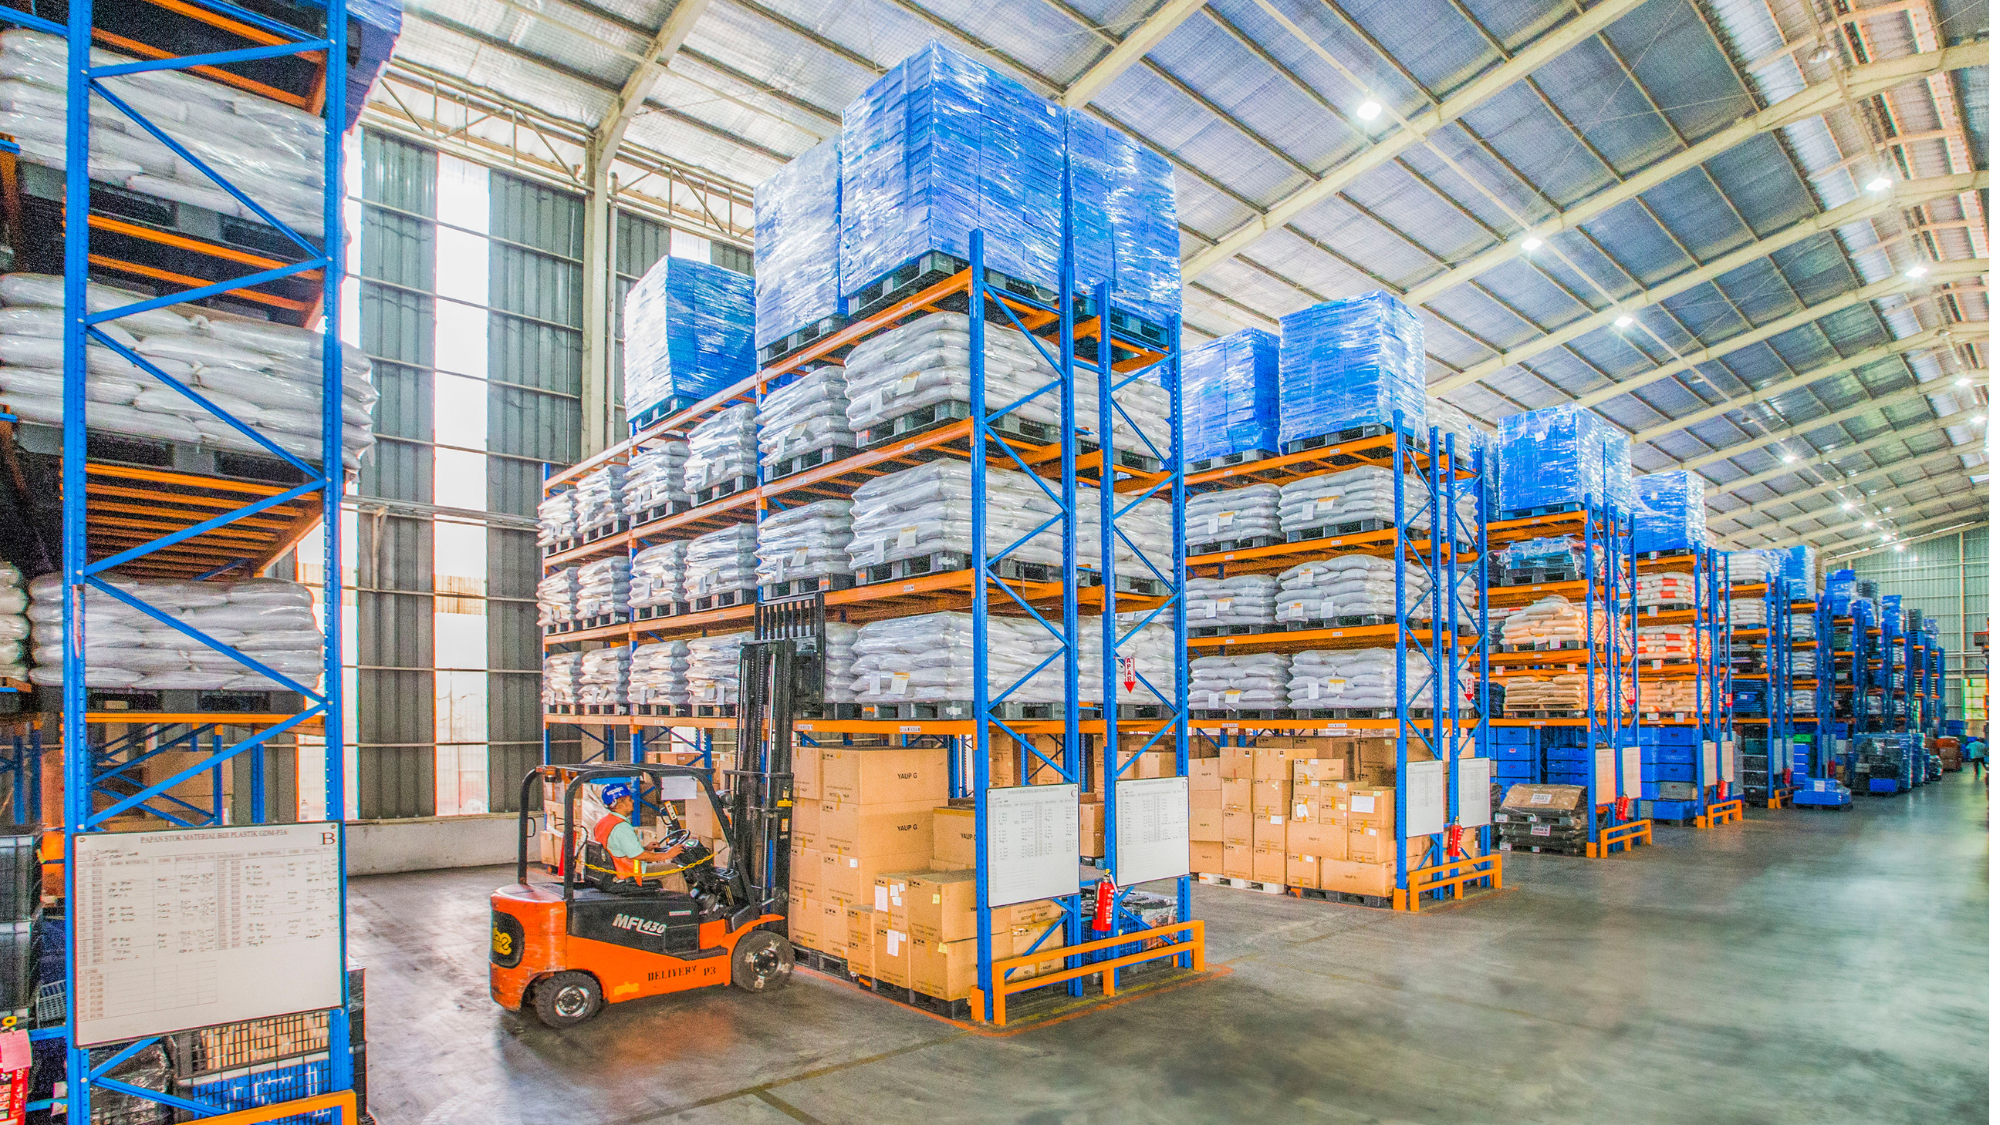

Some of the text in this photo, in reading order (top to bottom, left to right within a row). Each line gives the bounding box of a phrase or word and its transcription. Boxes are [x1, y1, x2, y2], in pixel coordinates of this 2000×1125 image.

[1071, 789, 1077, 797] C
[140, 836, 164, 844] PAPAN
[165, 834, 182, 842] STOK
[184, 832, 215, 841] MATERIAL
[321, 832, 336, 845] B
[648, 965, 716, 981] DELIVERY P3
